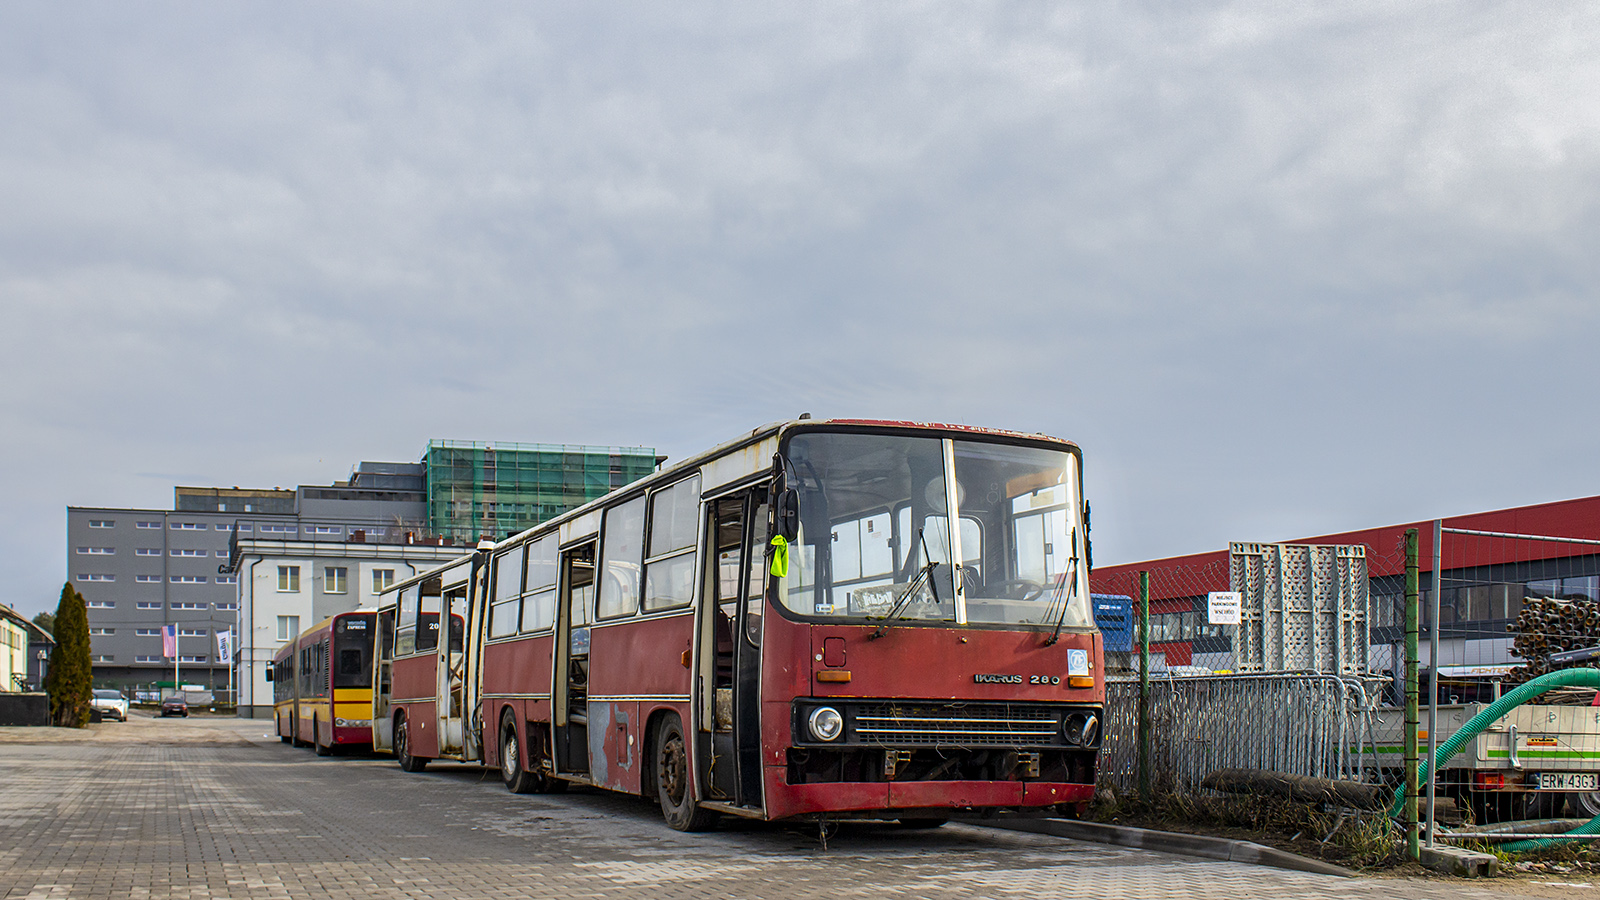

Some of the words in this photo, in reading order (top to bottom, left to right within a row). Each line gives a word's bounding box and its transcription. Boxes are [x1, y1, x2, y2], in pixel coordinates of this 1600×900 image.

[975, 674, 1023, 684] IKARUS
[1030, 675, 1060, 685] 280
[1541, 774, 1565, 788] ERW
[1568, 774, 1596, 789] 43G3
